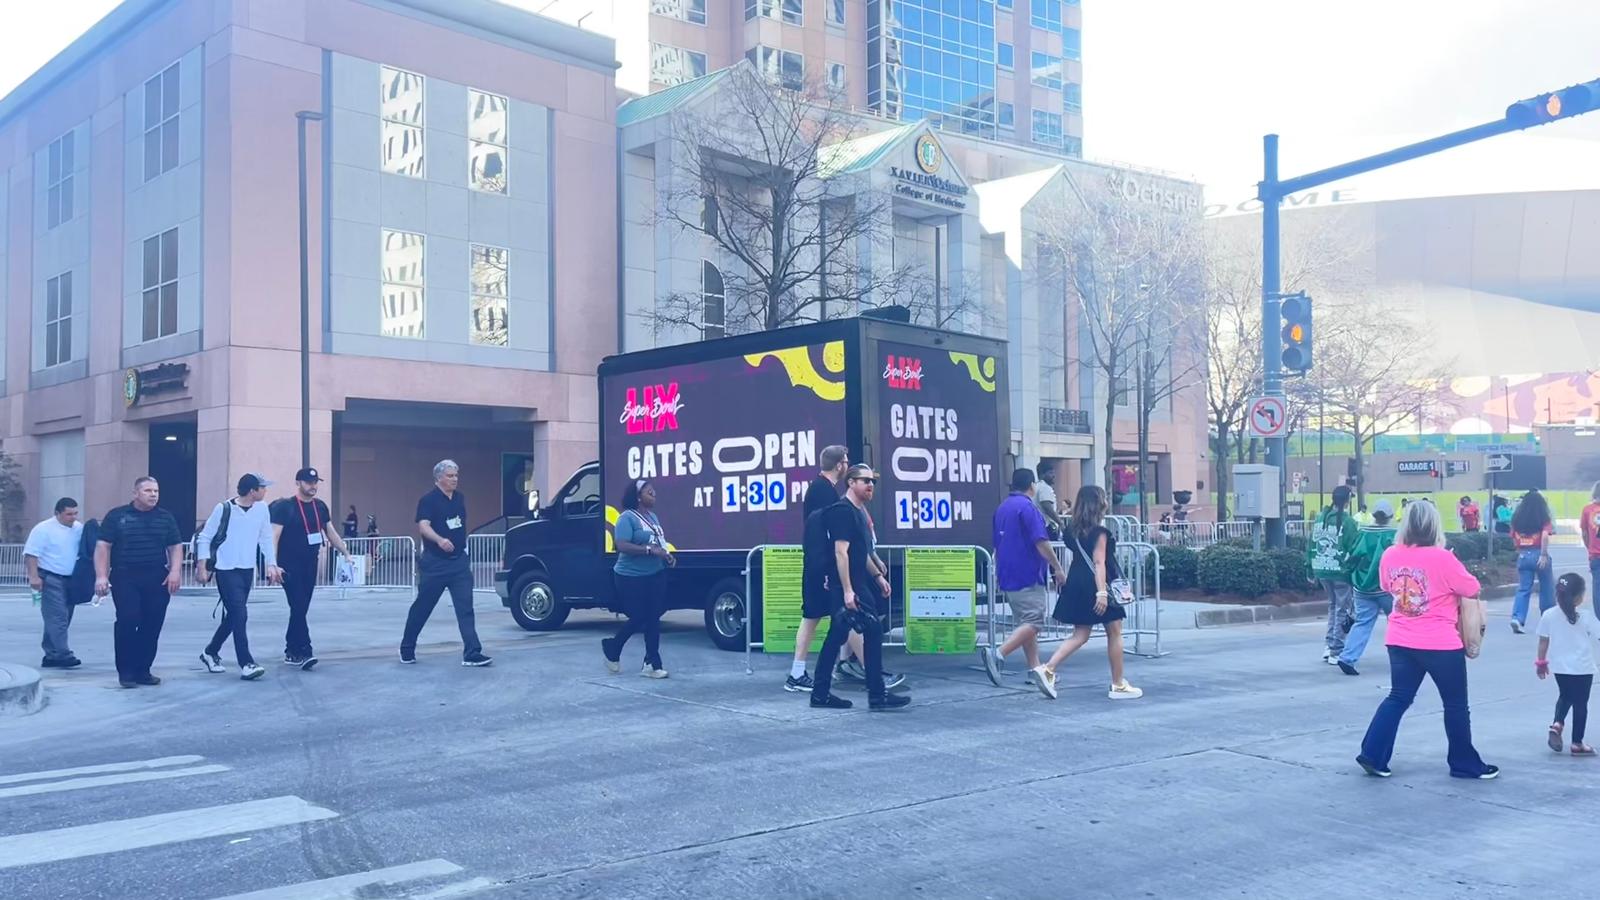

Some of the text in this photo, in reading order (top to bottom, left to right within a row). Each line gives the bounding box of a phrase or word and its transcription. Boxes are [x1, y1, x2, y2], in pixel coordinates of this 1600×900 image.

[895, 184, 966, 208] College of Medicine
[619, 393, 684, 425] Super Bowl
[626, 382, 678, 434] LIX
[891, 403, 958, 441] GATES
[627, 430, 815, 480] GATES OPEN
[892, 446, 991, 483] OPEN AT
[1399, 462, 1428, 471] GARAGE
[694, 486, 714, 507] AT
[725, 479, 786, 508] 1:30
[899, 497, 972, 523] 1:30 PM
